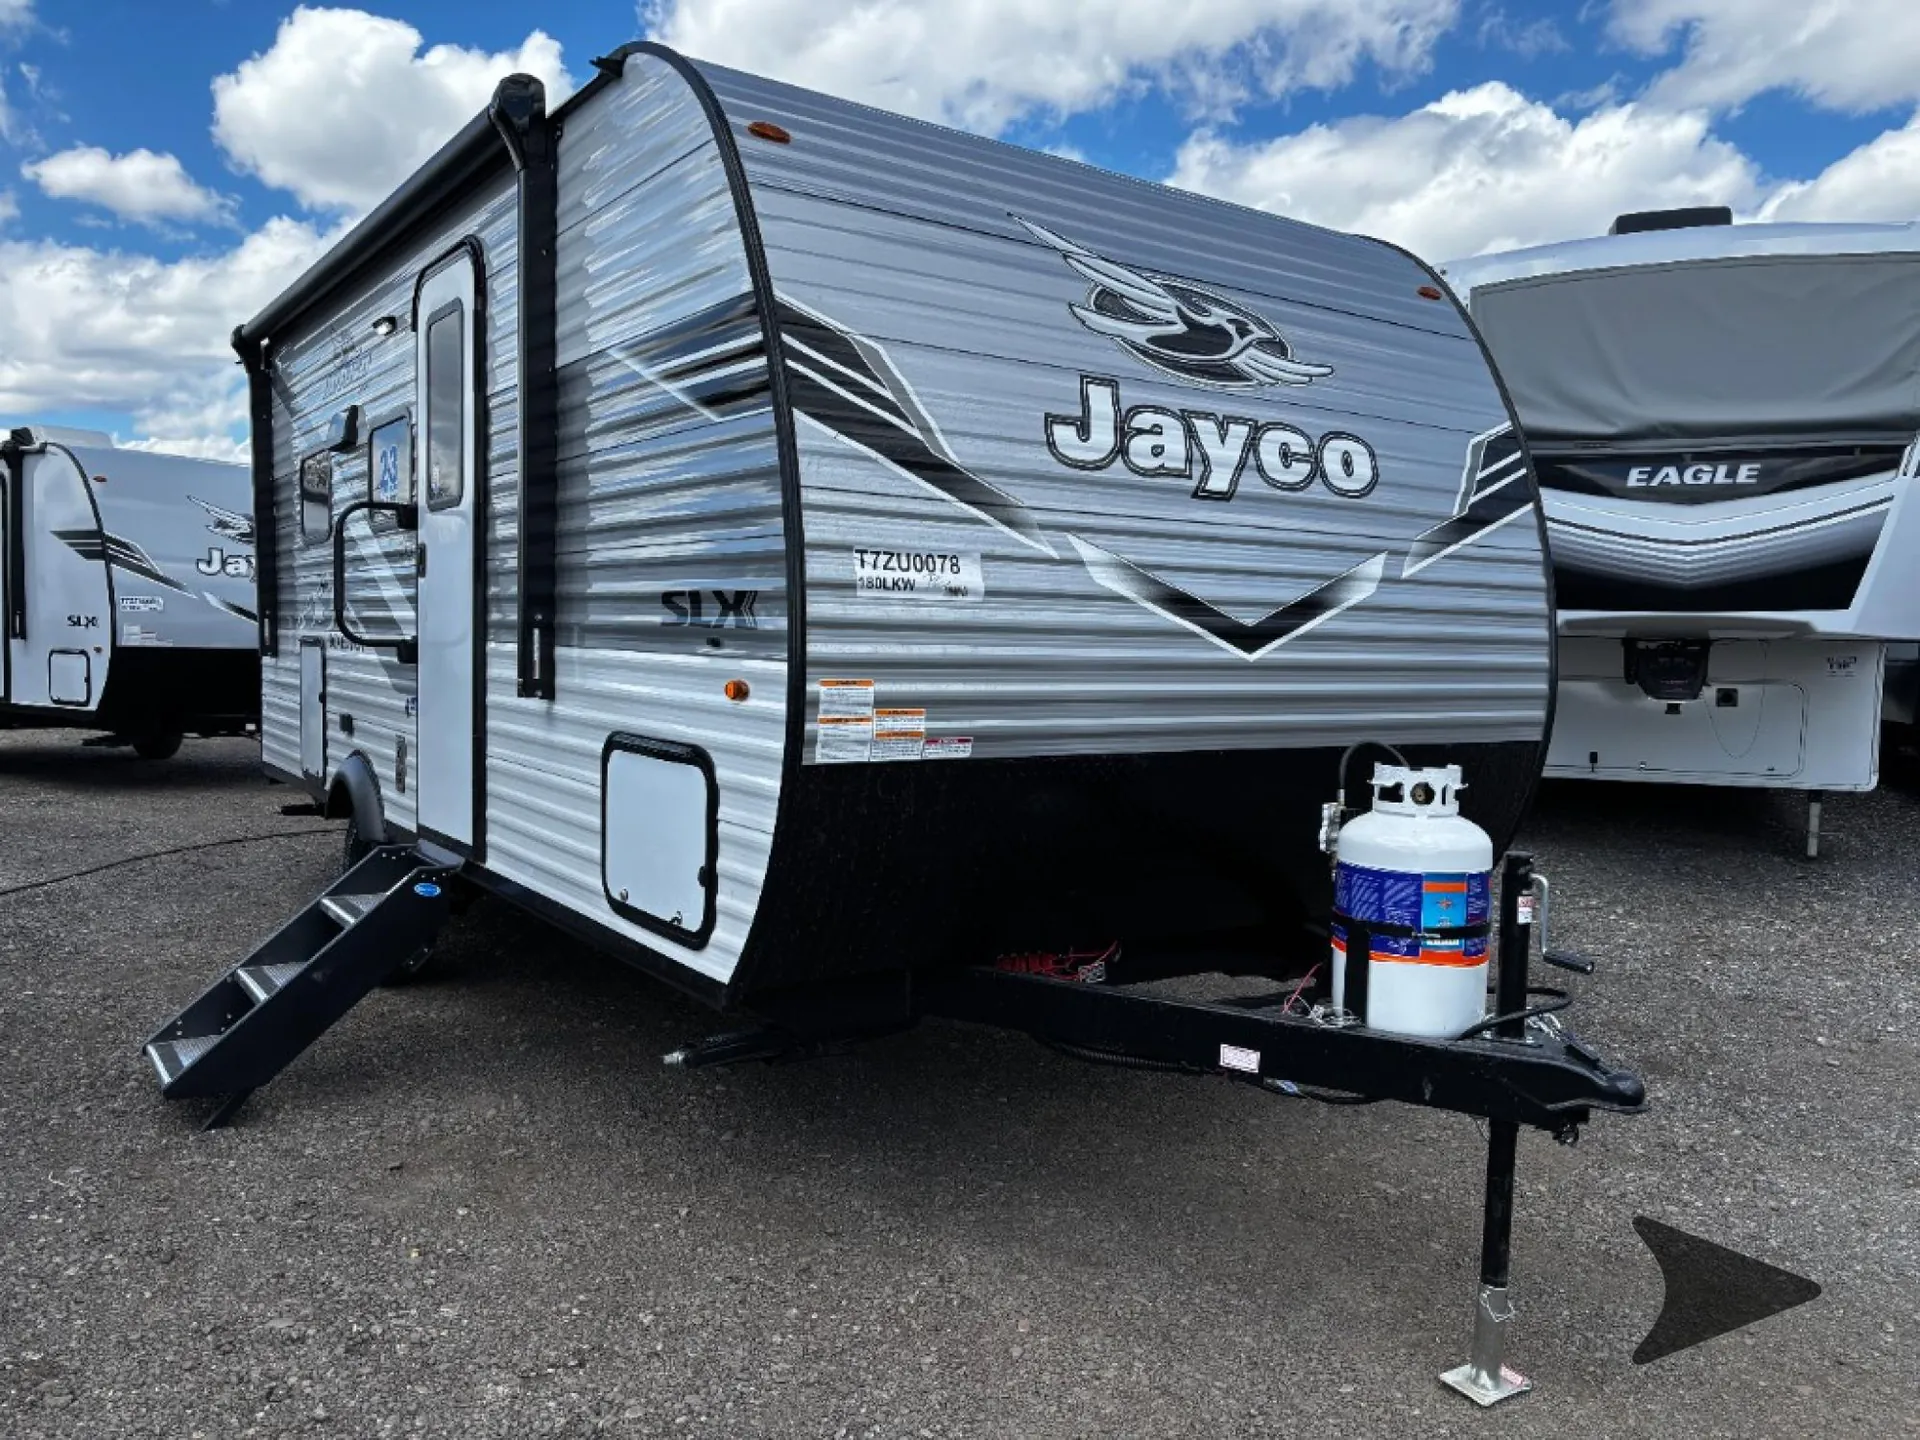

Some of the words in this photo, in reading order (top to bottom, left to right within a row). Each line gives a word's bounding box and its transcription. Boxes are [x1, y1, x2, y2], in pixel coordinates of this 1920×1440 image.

[1044, 374, 1380, 502] Jayco
[1626, 463, 1761, 487] EAGLE
[854, 548, 961, 575] T7ZU0078
[661, 589, 758, 629] SLX
